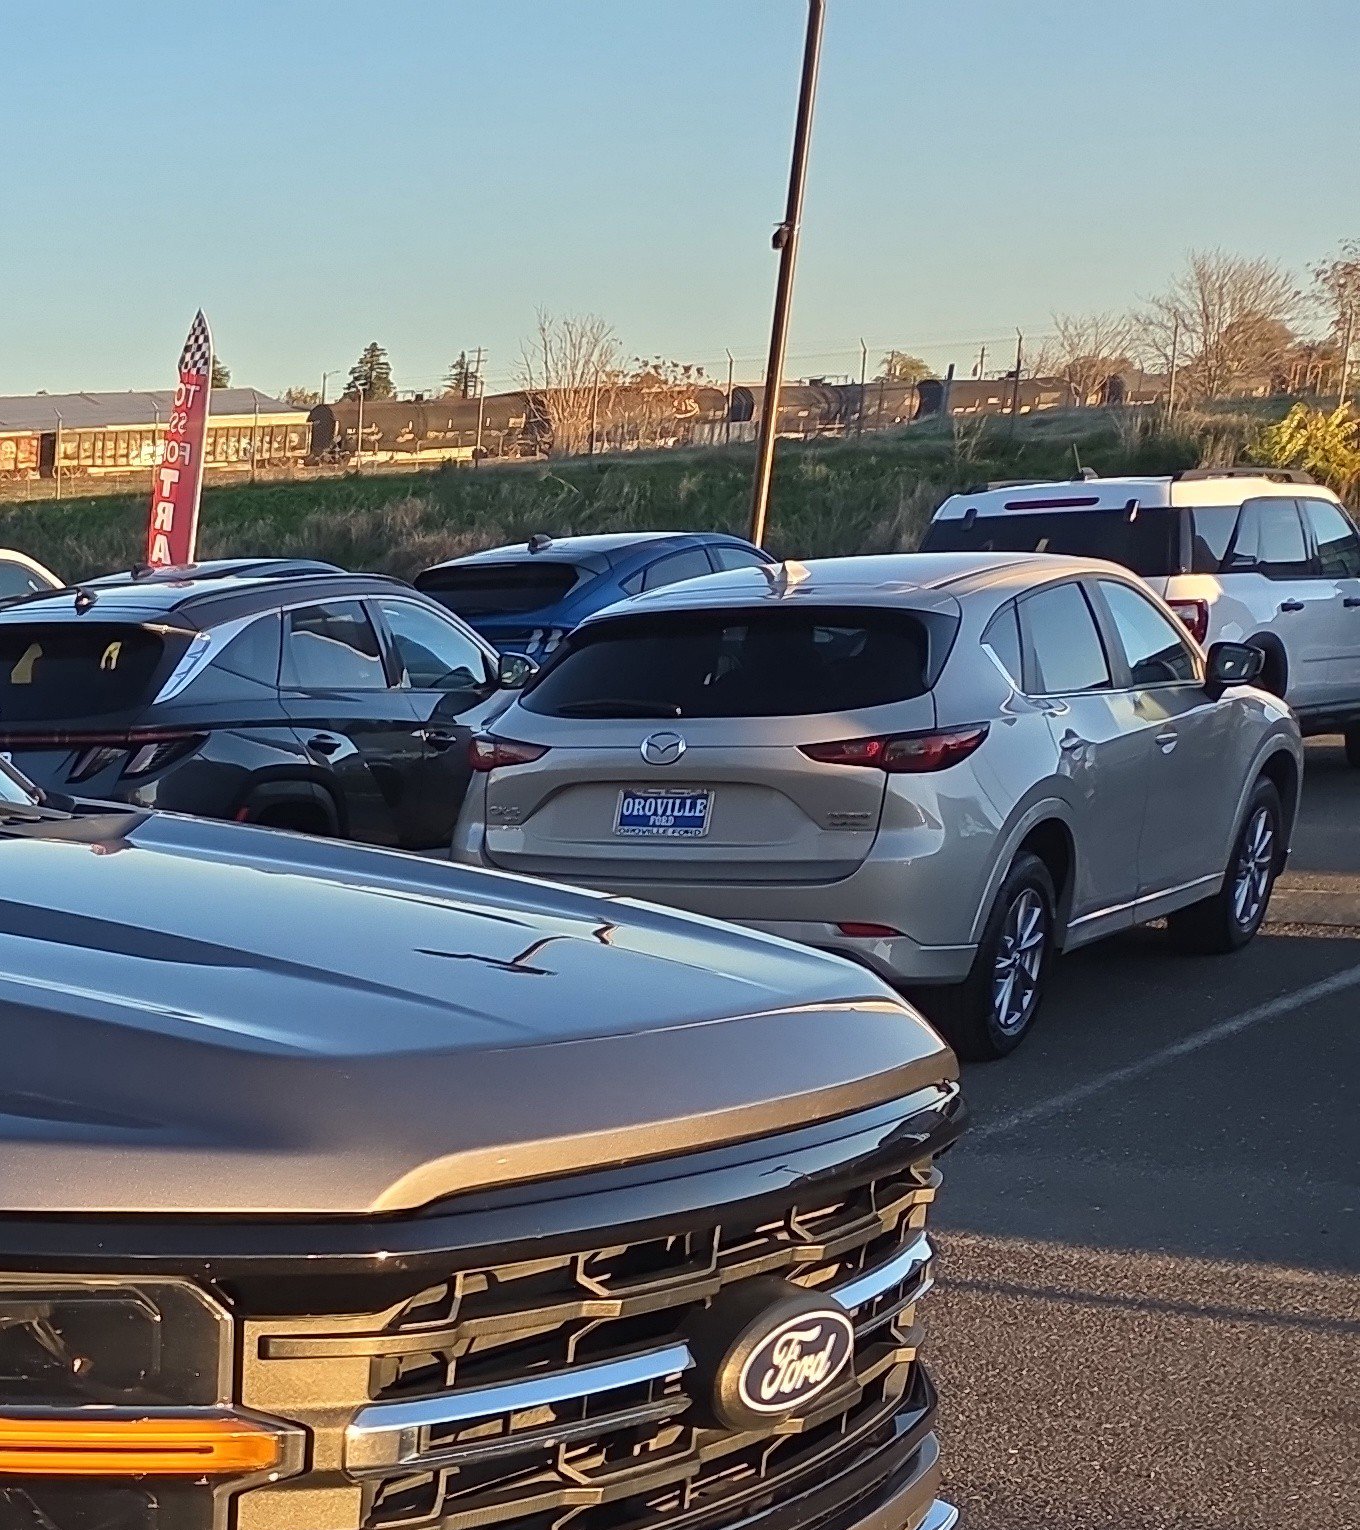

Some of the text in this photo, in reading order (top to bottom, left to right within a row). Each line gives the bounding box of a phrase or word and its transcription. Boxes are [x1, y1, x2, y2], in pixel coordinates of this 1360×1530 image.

[622, 798, 707, 817] OROVILLE
[649, 816, 674, 826] FORD
[618, 828, 702, 837] OROVILLE FORD
[760, 1323, 838, 1401] Ford
